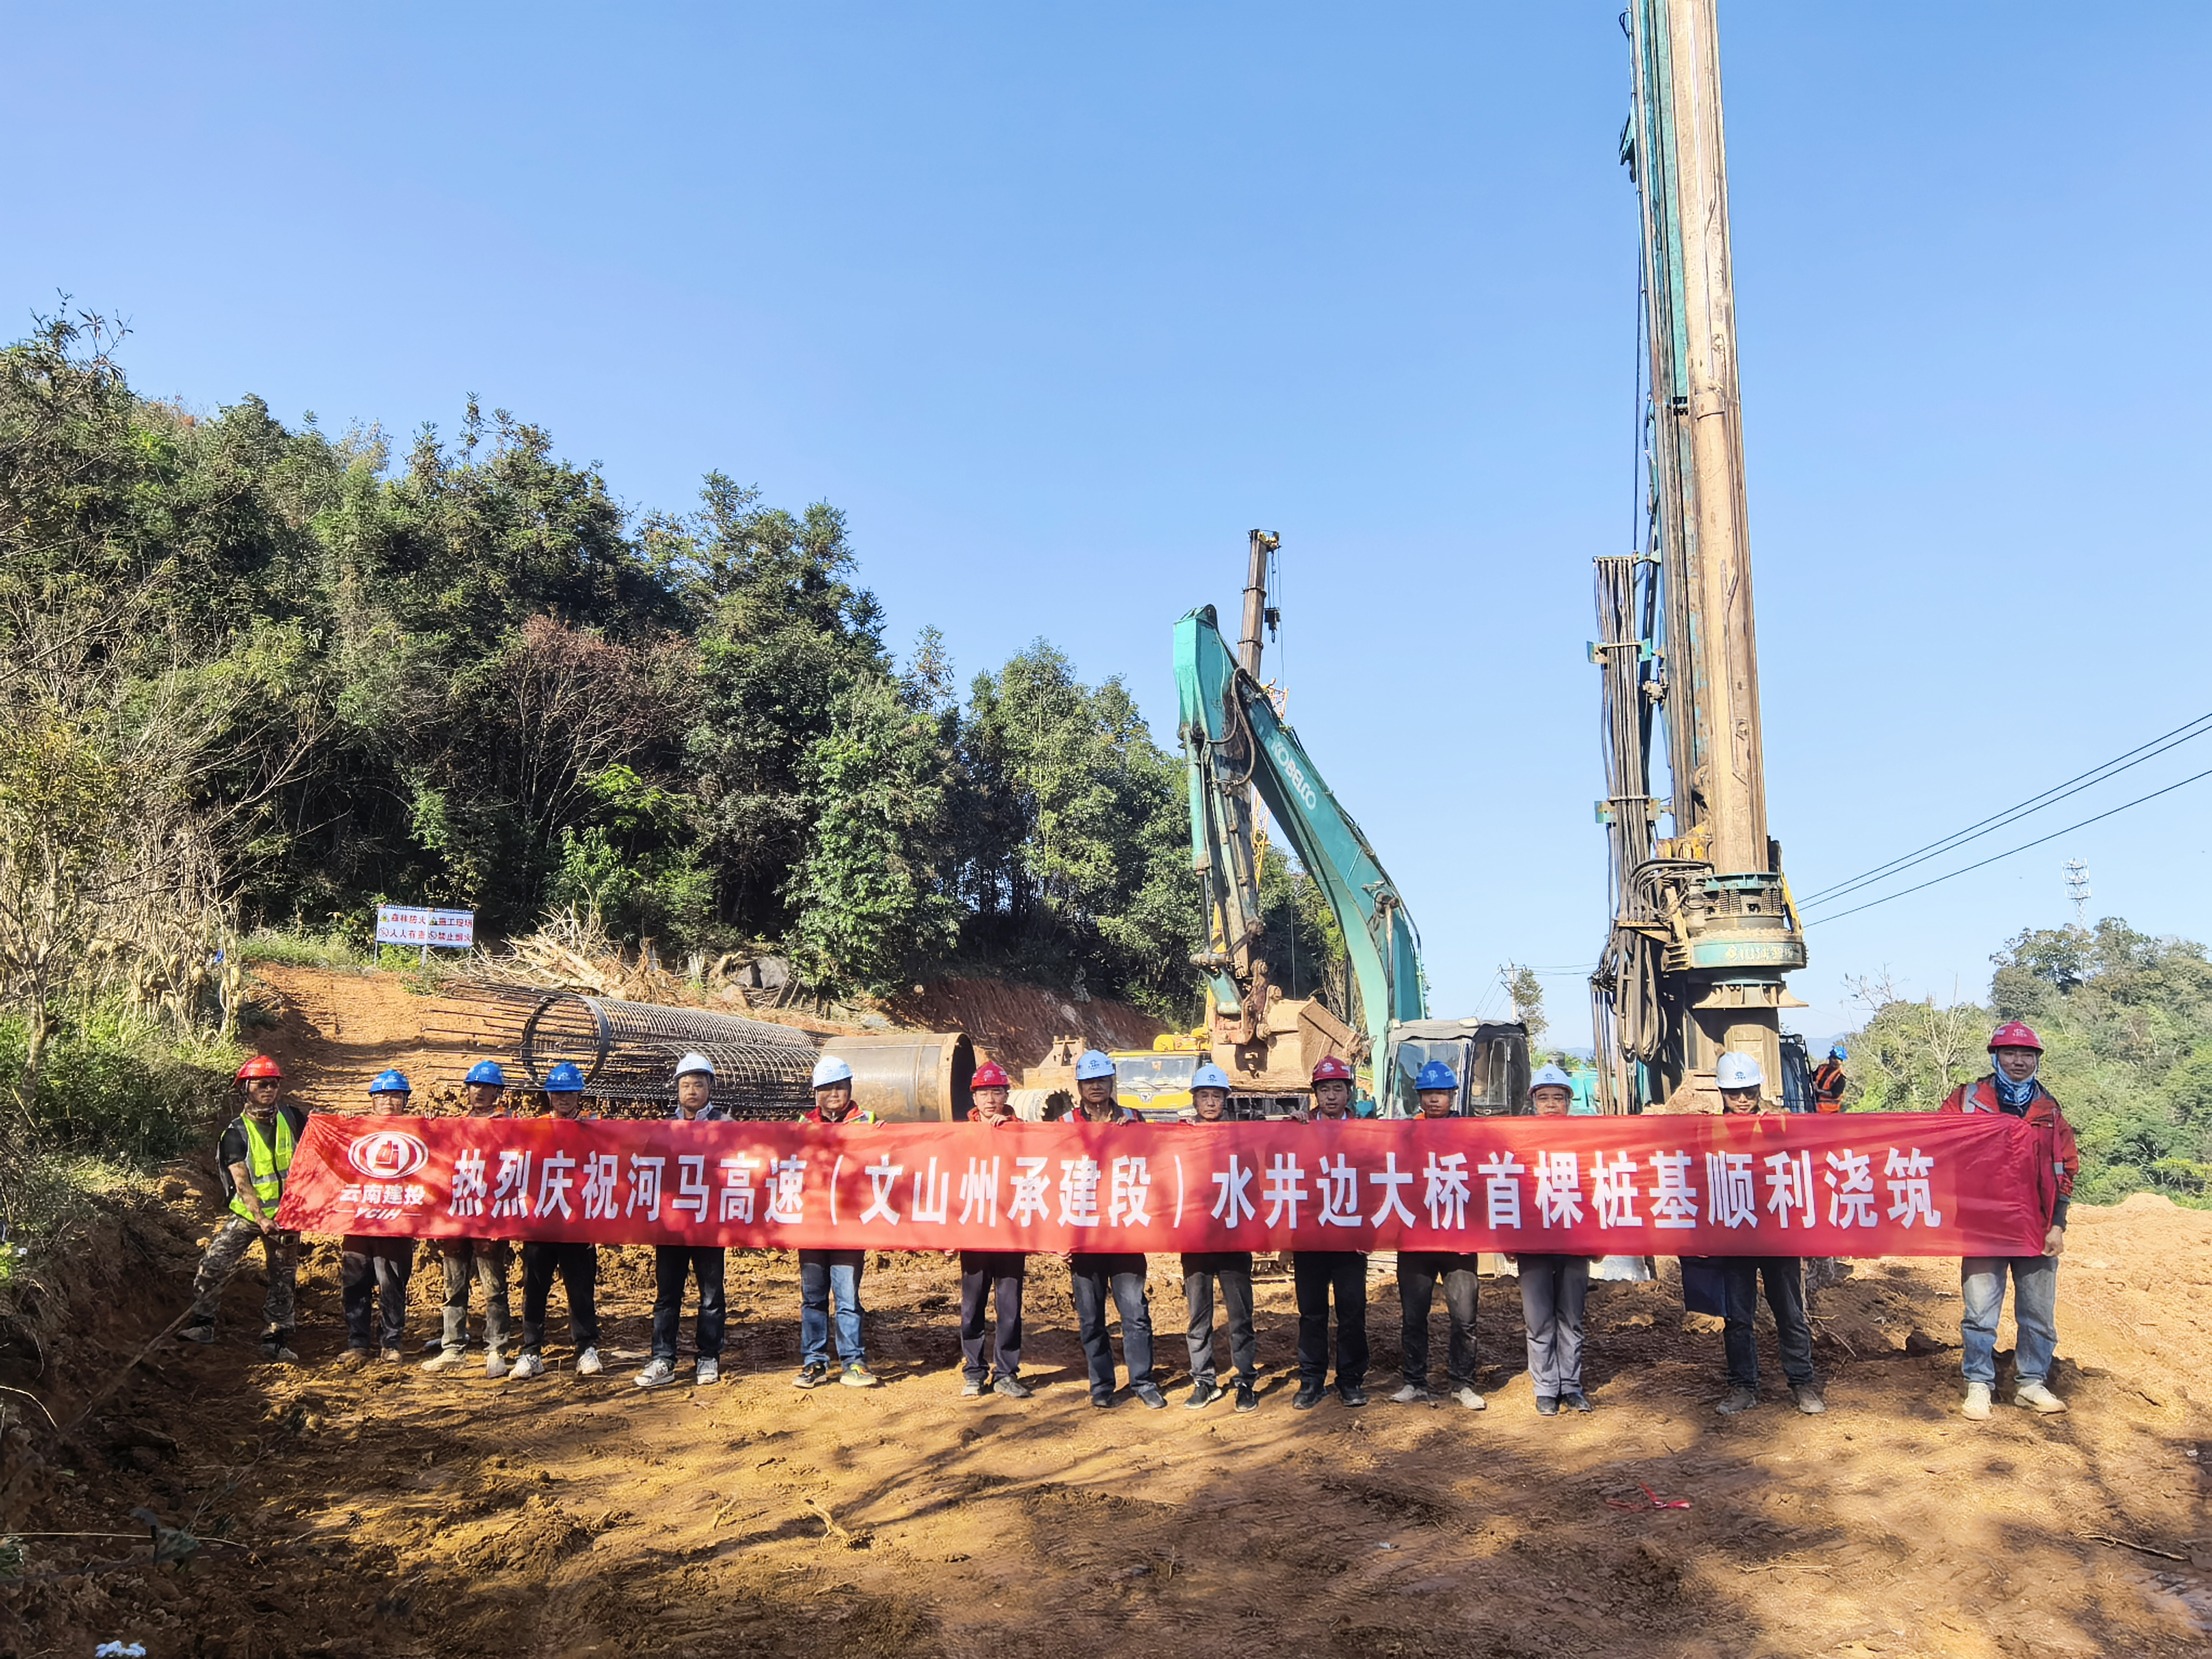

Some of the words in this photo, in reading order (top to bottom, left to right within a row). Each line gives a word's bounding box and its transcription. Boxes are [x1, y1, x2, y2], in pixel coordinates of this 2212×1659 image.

[1270, 740, 1317, 810] KOBELCO
[339, 1183, 426, 1205] 云南建投
[354, 1207, 403, 1220] YCIH
